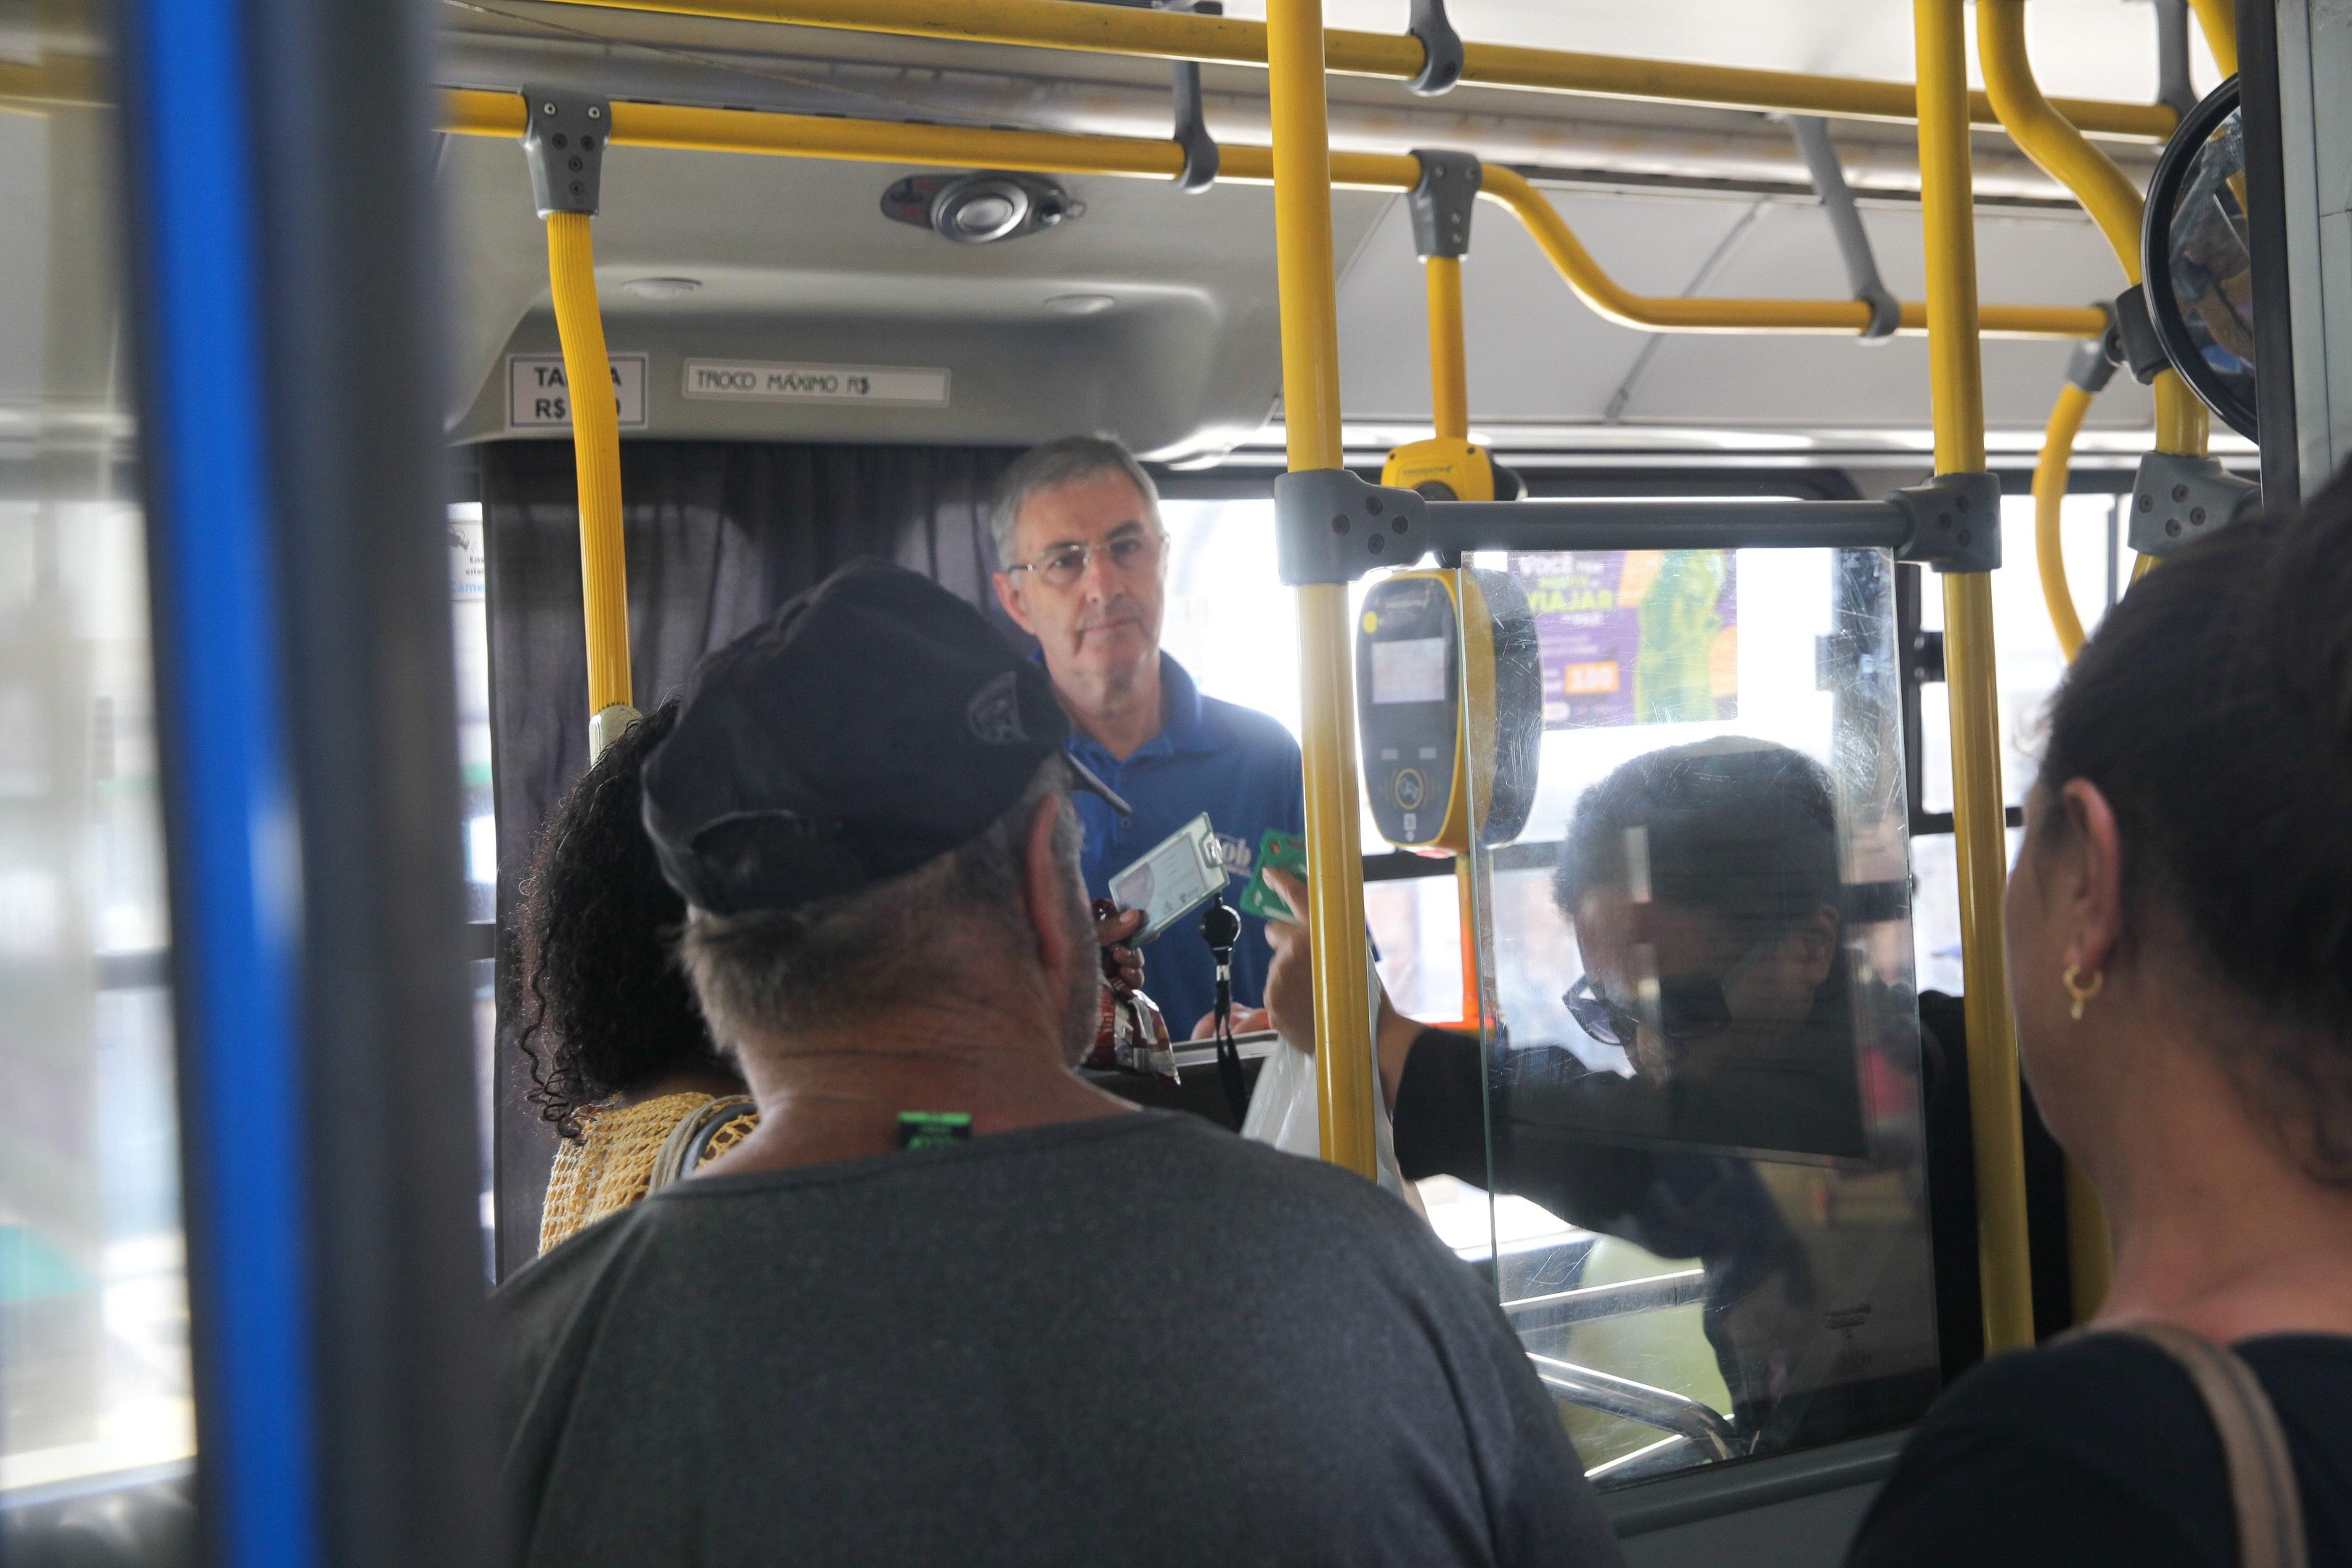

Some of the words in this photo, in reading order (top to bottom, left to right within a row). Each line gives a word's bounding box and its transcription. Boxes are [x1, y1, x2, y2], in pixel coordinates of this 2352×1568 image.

[534, 367, 621, 387] TAA
[697, 369, 756, 391] TROCO
[767, 368, 838, 393] MÁXIMO
[535, 397, 566, 419] R$
